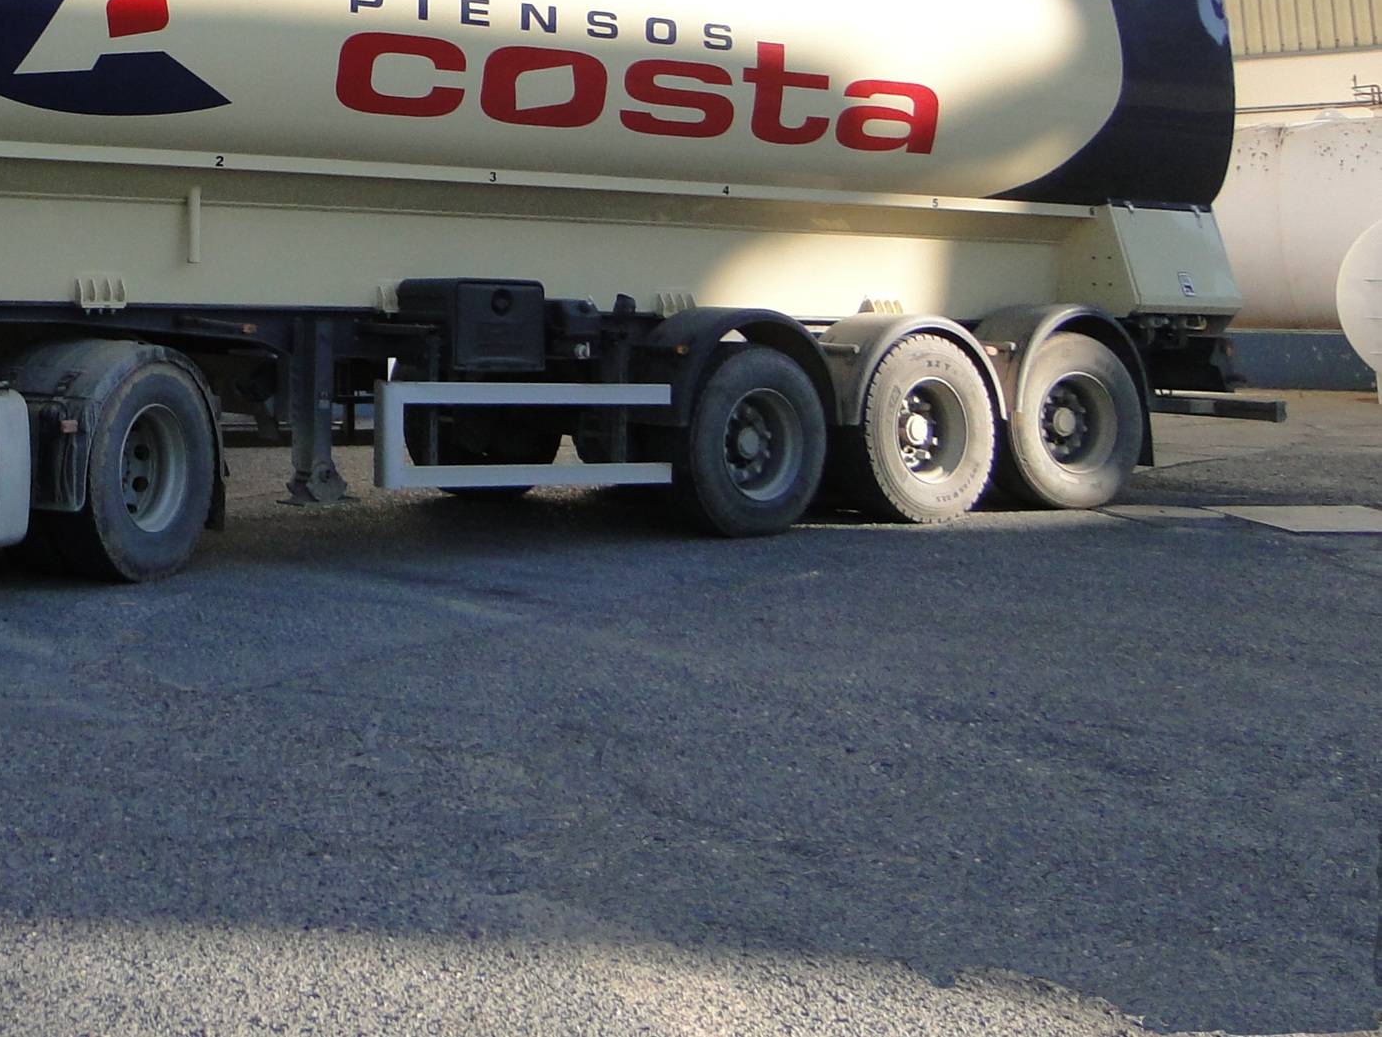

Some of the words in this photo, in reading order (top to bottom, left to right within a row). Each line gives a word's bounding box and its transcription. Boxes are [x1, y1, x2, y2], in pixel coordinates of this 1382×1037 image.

[335, 31, 940, 155] costa
[215, 155, 224, 167] 2
[489, 171, 497, 182] 3
[722, 185, 730, 195] 4
[932, 198, 939, 208] 5
[1089, 207, 1095, 216] 6
